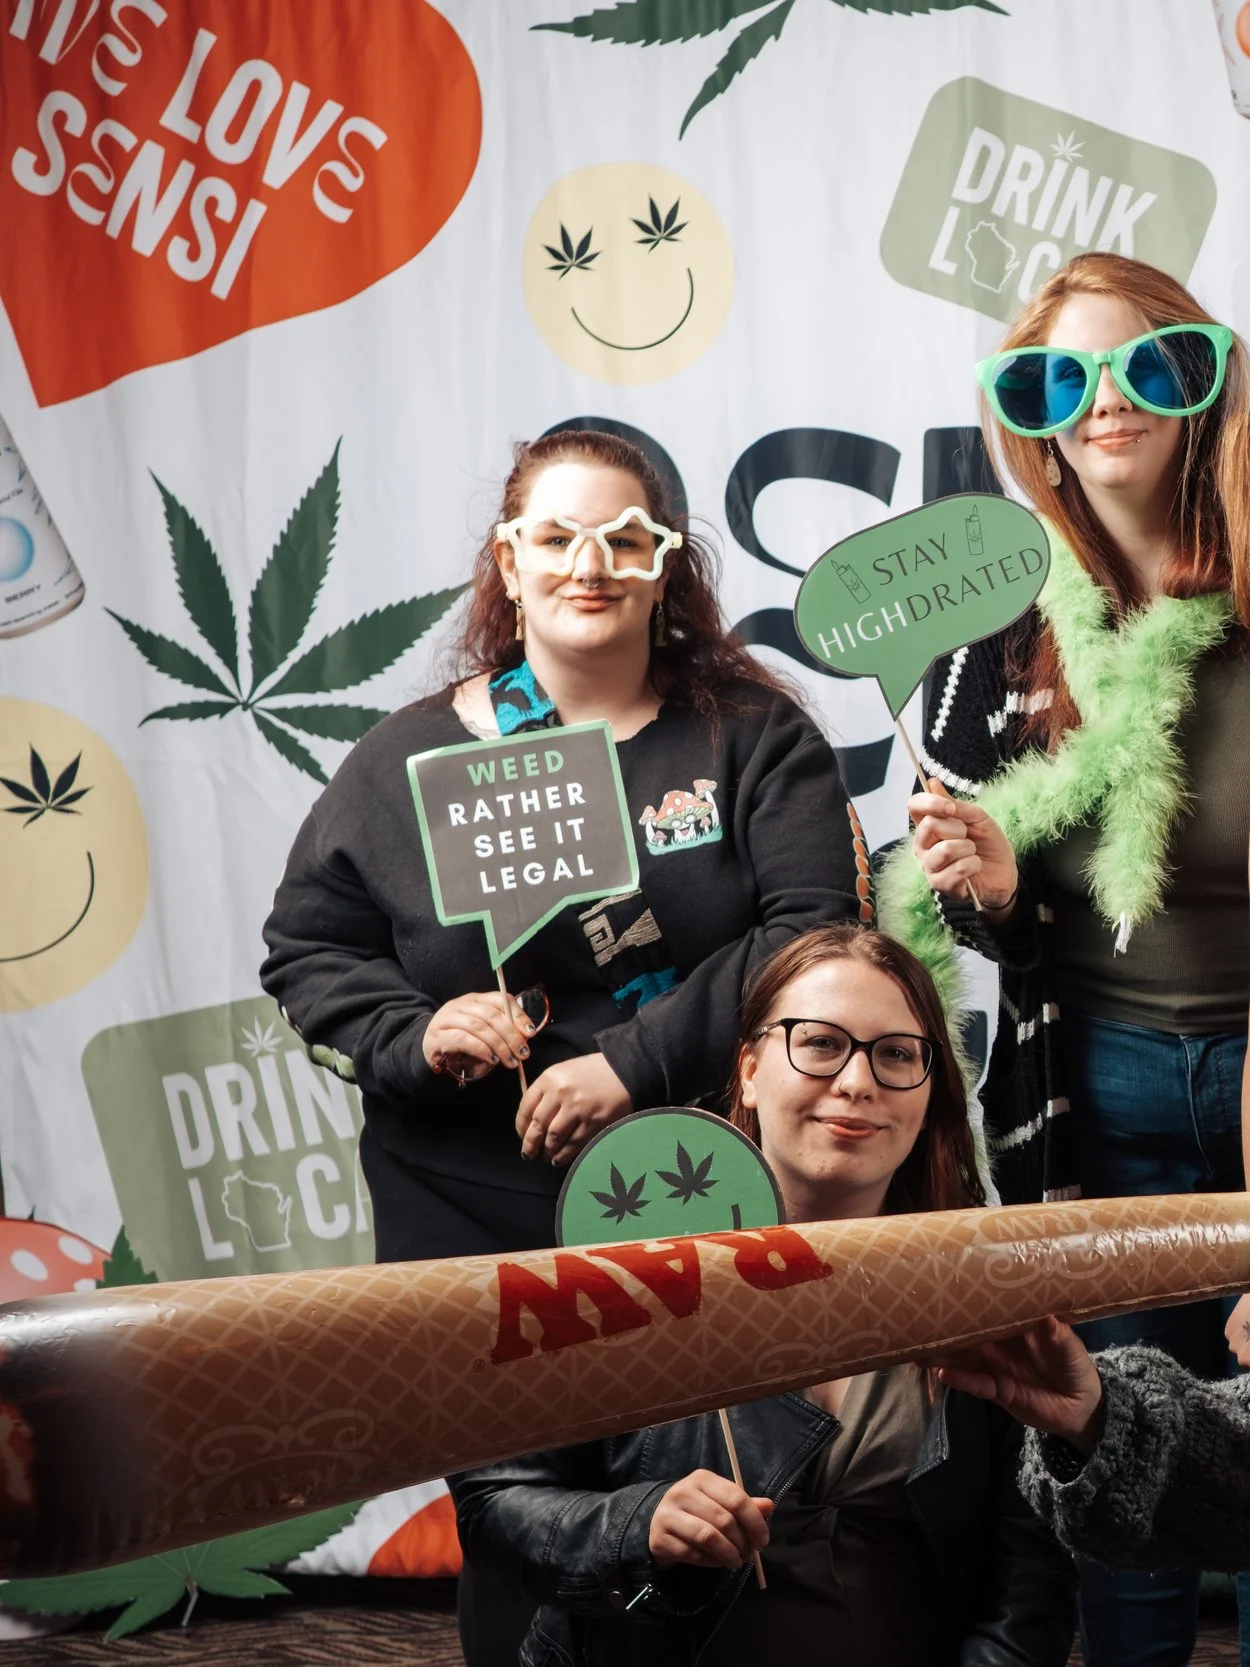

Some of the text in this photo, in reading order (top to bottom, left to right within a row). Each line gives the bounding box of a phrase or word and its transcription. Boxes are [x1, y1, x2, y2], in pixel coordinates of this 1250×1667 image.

[159, 28, 388, 223] LOVE
[11, 90, 267, 300] SENSI
[951, 126, 1158, 258] DRINK
[817, 548, 1043, 659] HIGHDRATED
[872, 533, 950, 586] STAY
[448, 782, 586, 827] RATHER
[466, 750, 564, 786] WEED
[474, 818, 585, 858] SEE IT
[480, 854, 594, 893] LEGAL
[162, 1049, 366, 1170] DRIN
[491, 1225, 833, 1366] RAW
